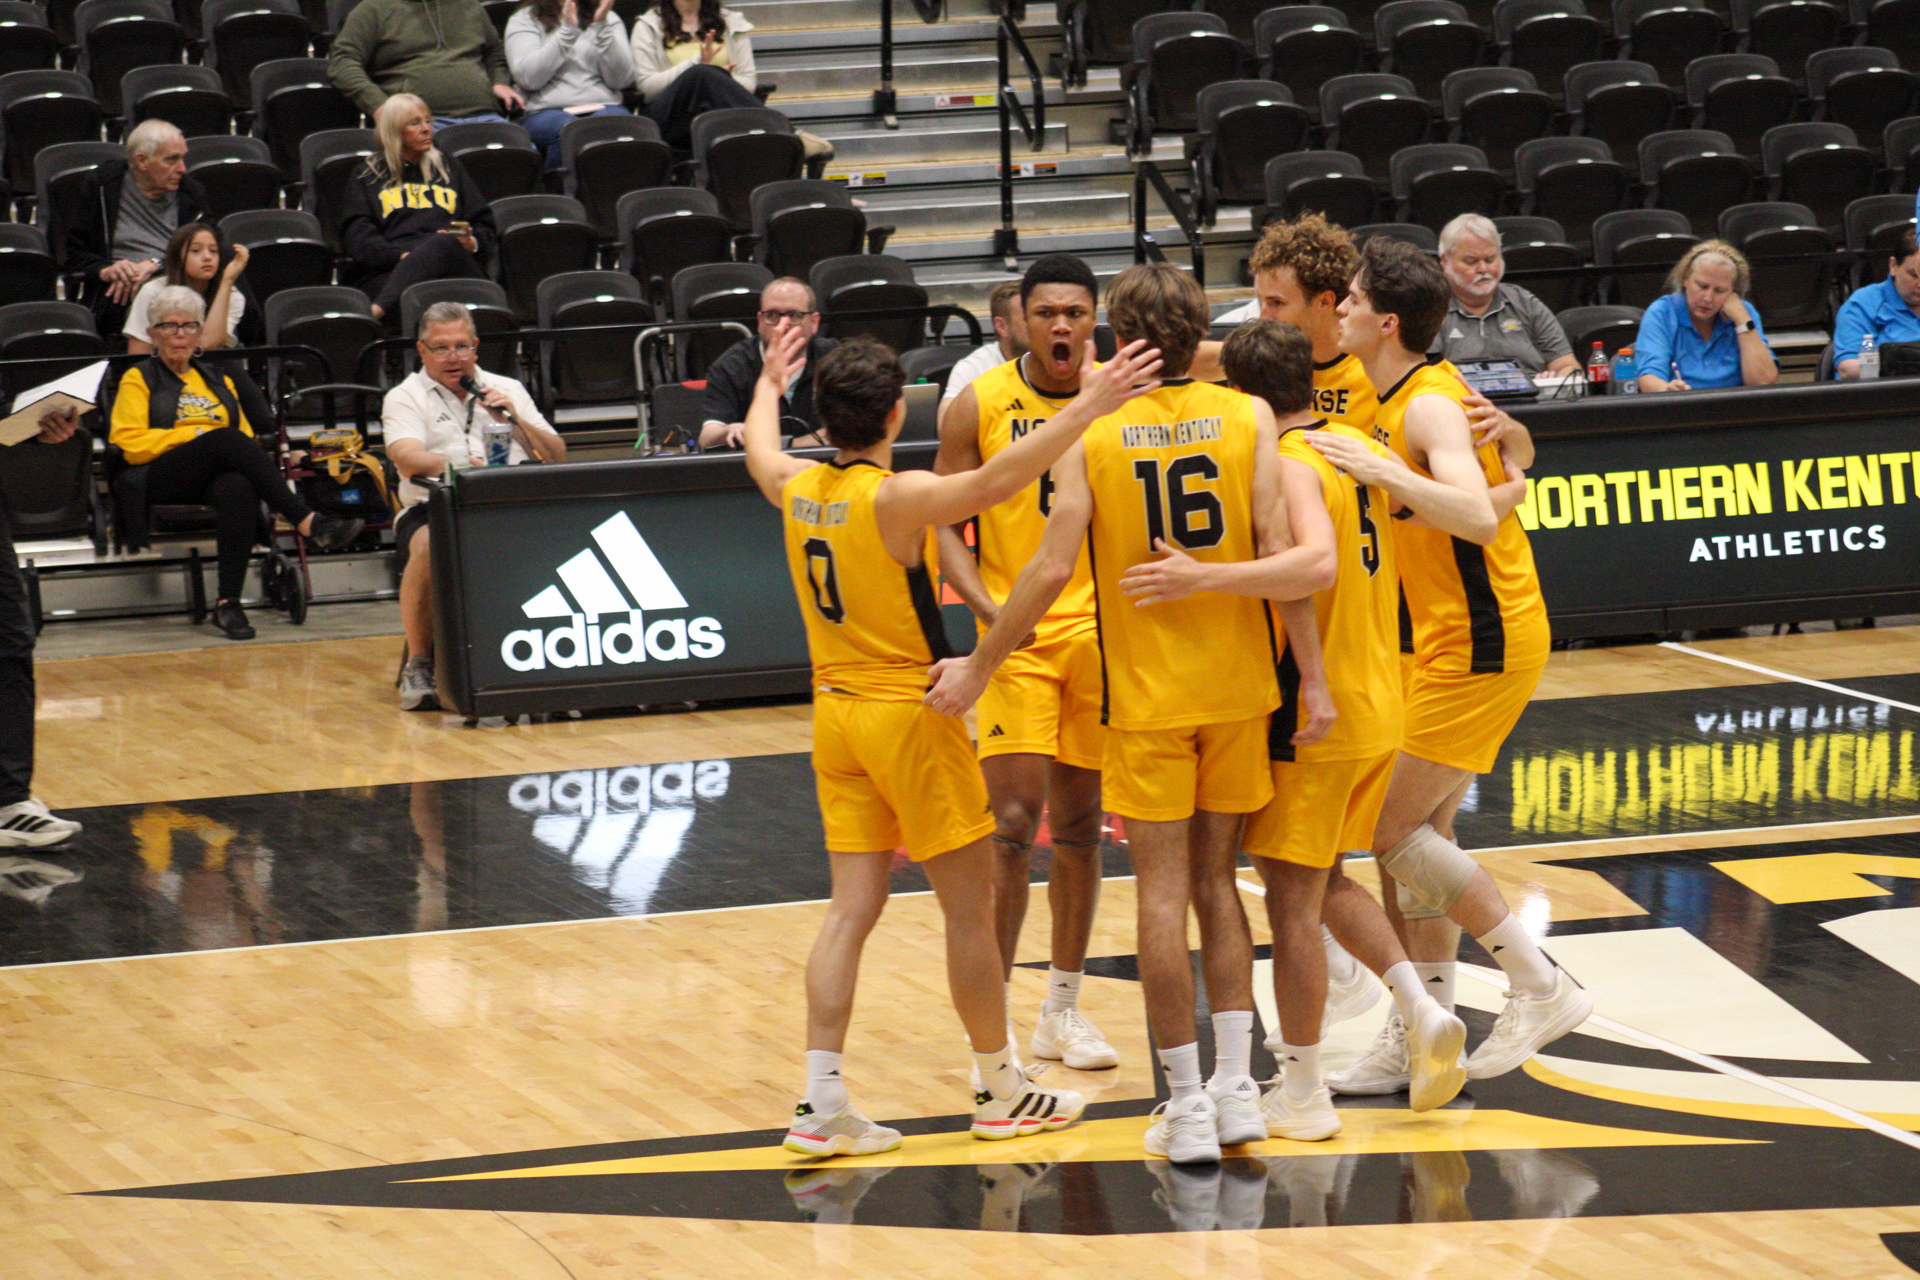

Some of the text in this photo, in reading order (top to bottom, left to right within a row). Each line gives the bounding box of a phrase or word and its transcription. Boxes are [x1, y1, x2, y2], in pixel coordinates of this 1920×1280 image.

[378, 183, 457, 219] NKU
[1133, 453, 1226, 553] 16
[1355, 483, 1381, 579] 5
[1514, 451, 1920, 531] NORTHERN KENT
[803, 535, 847, 625] 0
[1688, 524, 1887, 563] ATHLETICS
[501, 609, 726, 672] adidas
